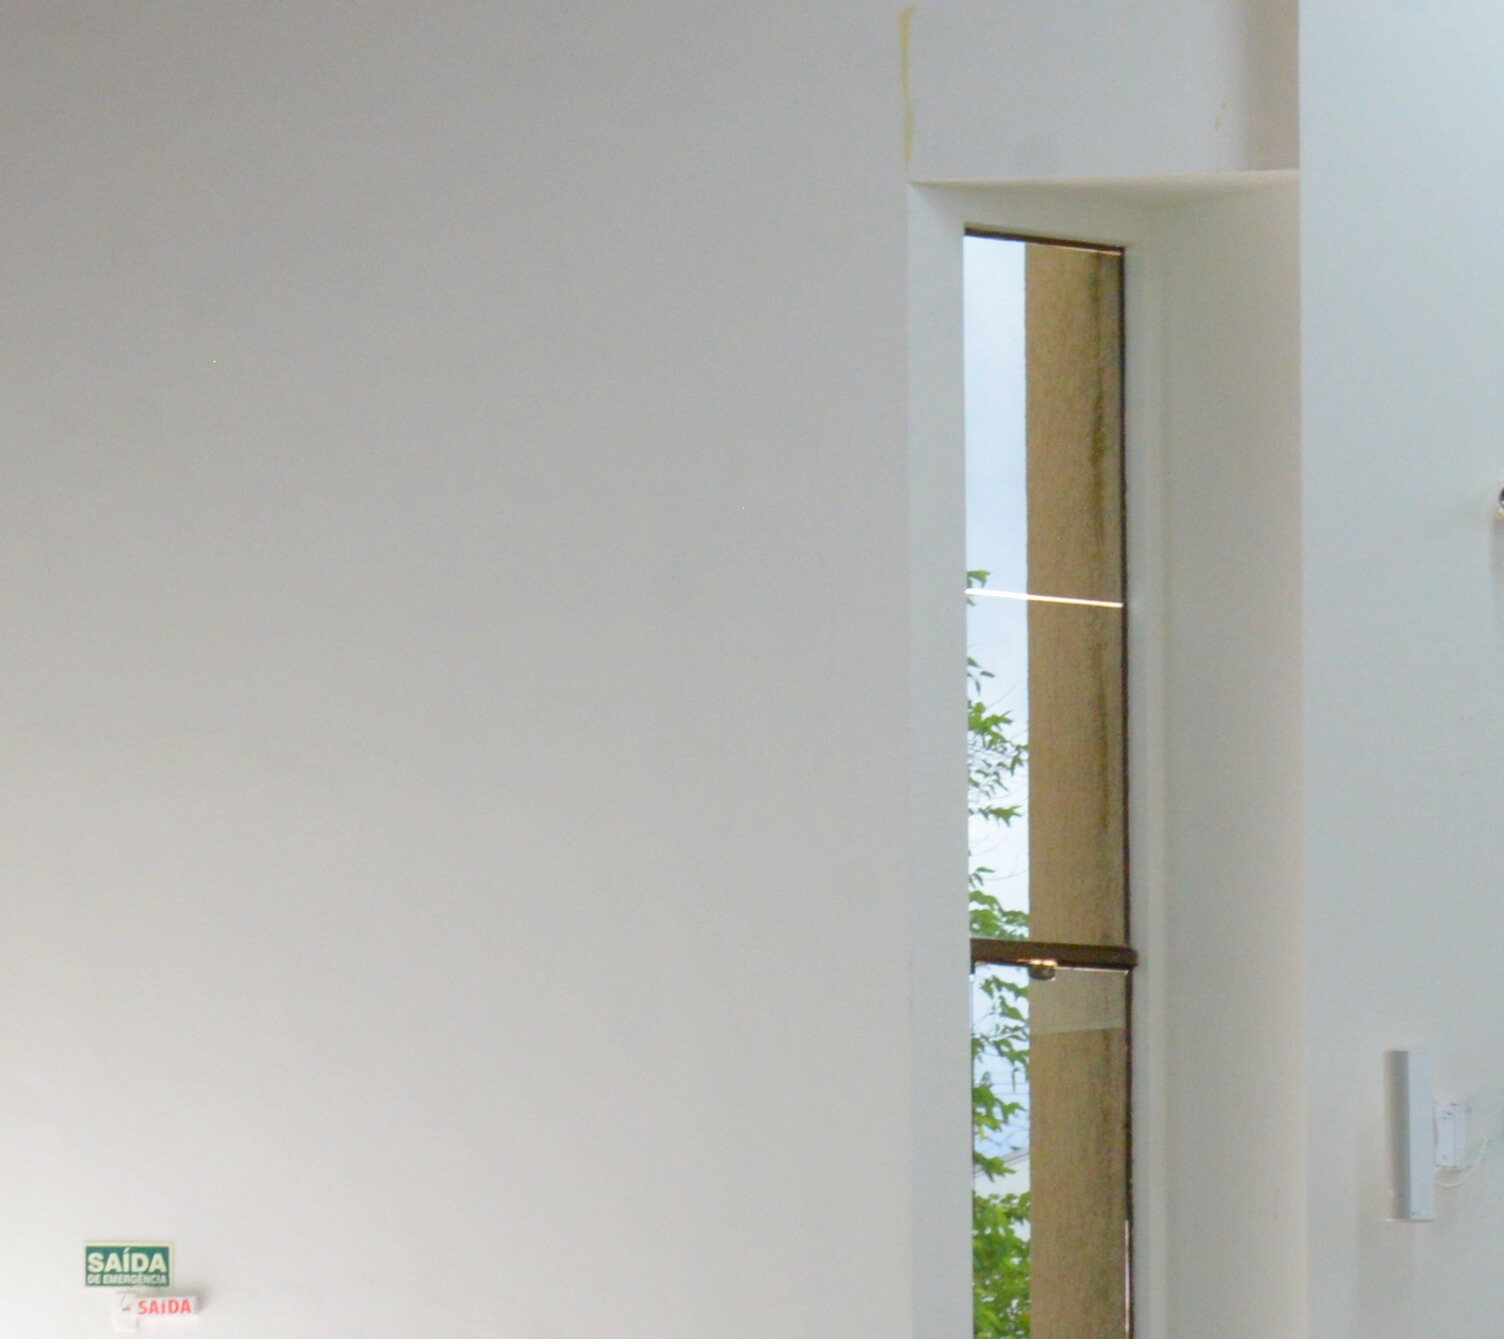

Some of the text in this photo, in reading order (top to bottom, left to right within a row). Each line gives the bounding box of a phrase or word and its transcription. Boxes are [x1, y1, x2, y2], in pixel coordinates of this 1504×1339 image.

[88, 1247, 167, 1272] SAÍDA
[87, 1273, 167, 1285] DE EMERGÊNCIA
